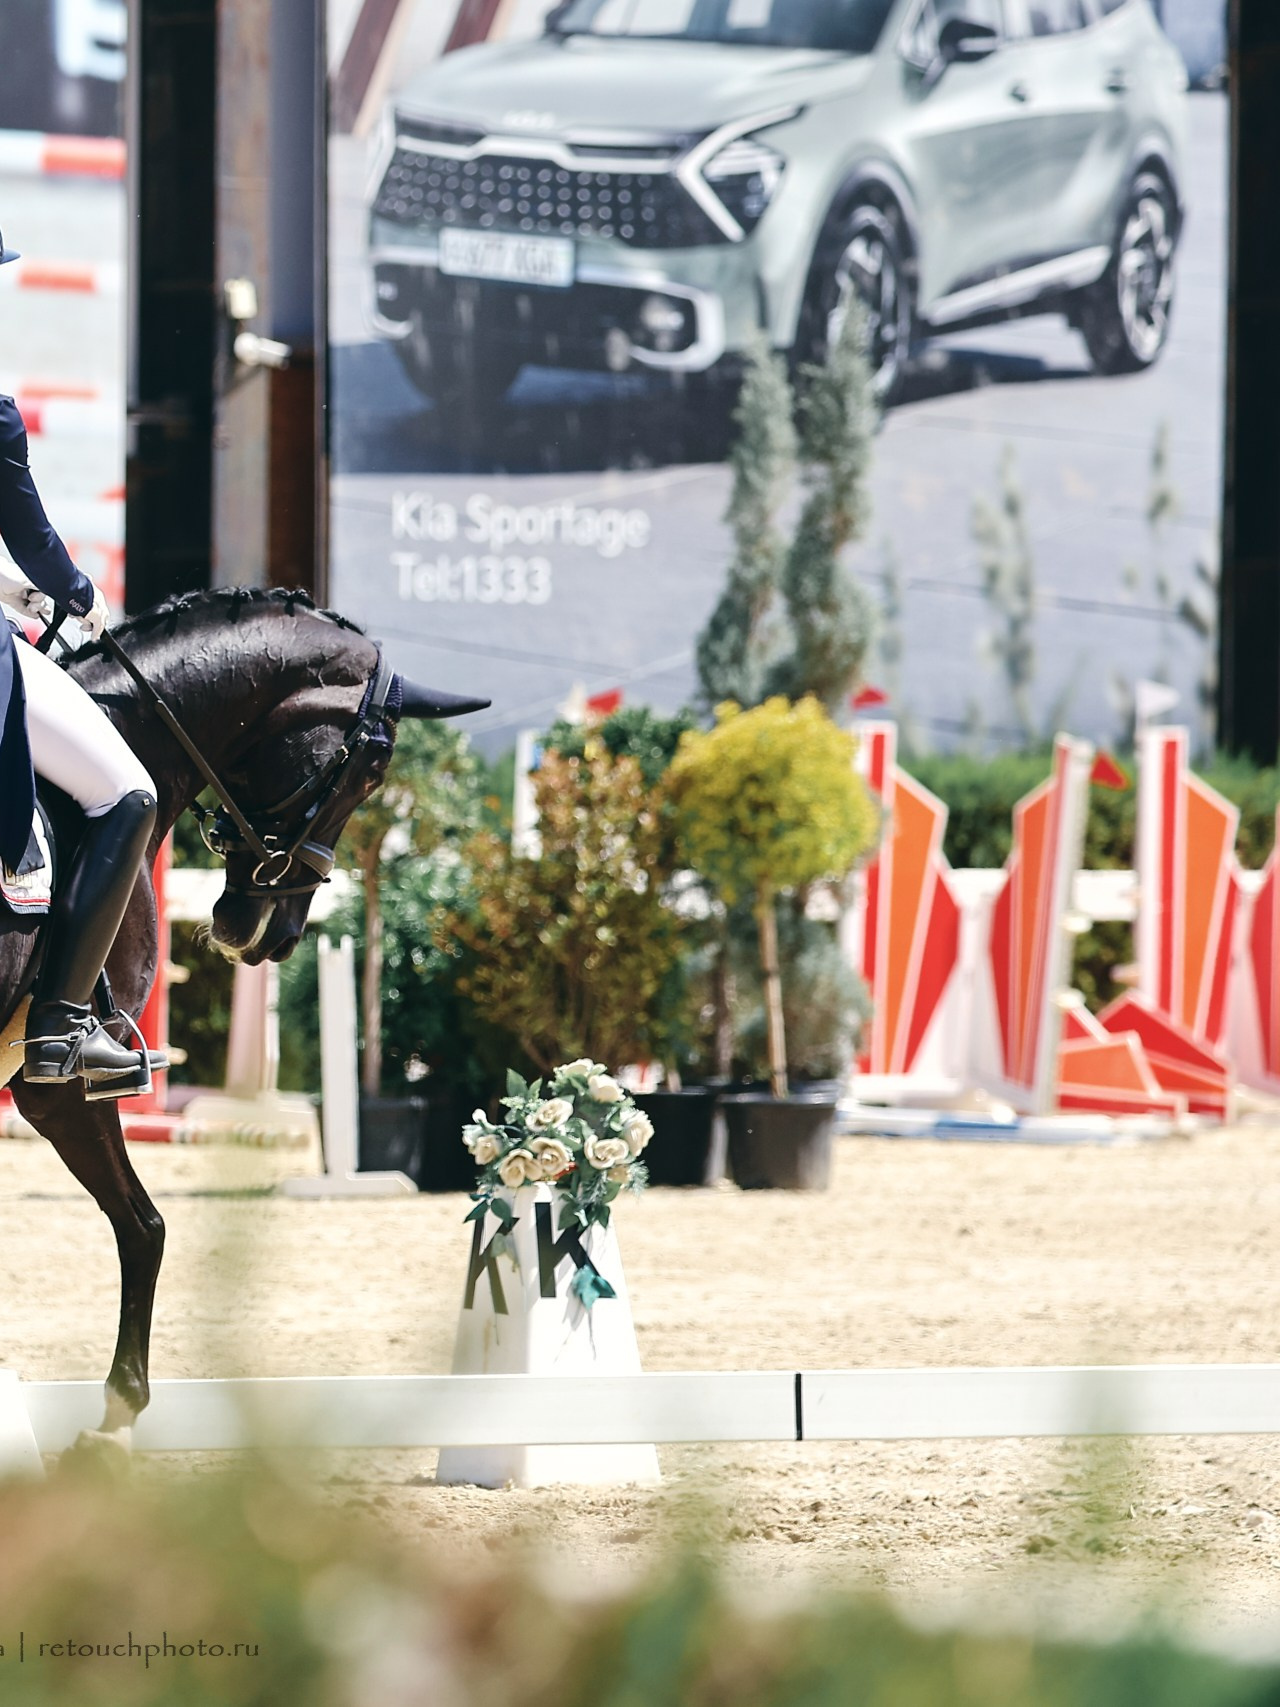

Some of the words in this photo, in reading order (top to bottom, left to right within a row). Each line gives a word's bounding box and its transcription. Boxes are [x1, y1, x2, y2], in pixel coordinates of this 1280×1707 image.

[391, 491, 458, 541] Kia
[465, 493, 651, 558] Sportage
[390, 552, 552, 605] Tel:1333
[535, 1202, 618, 1298] K
